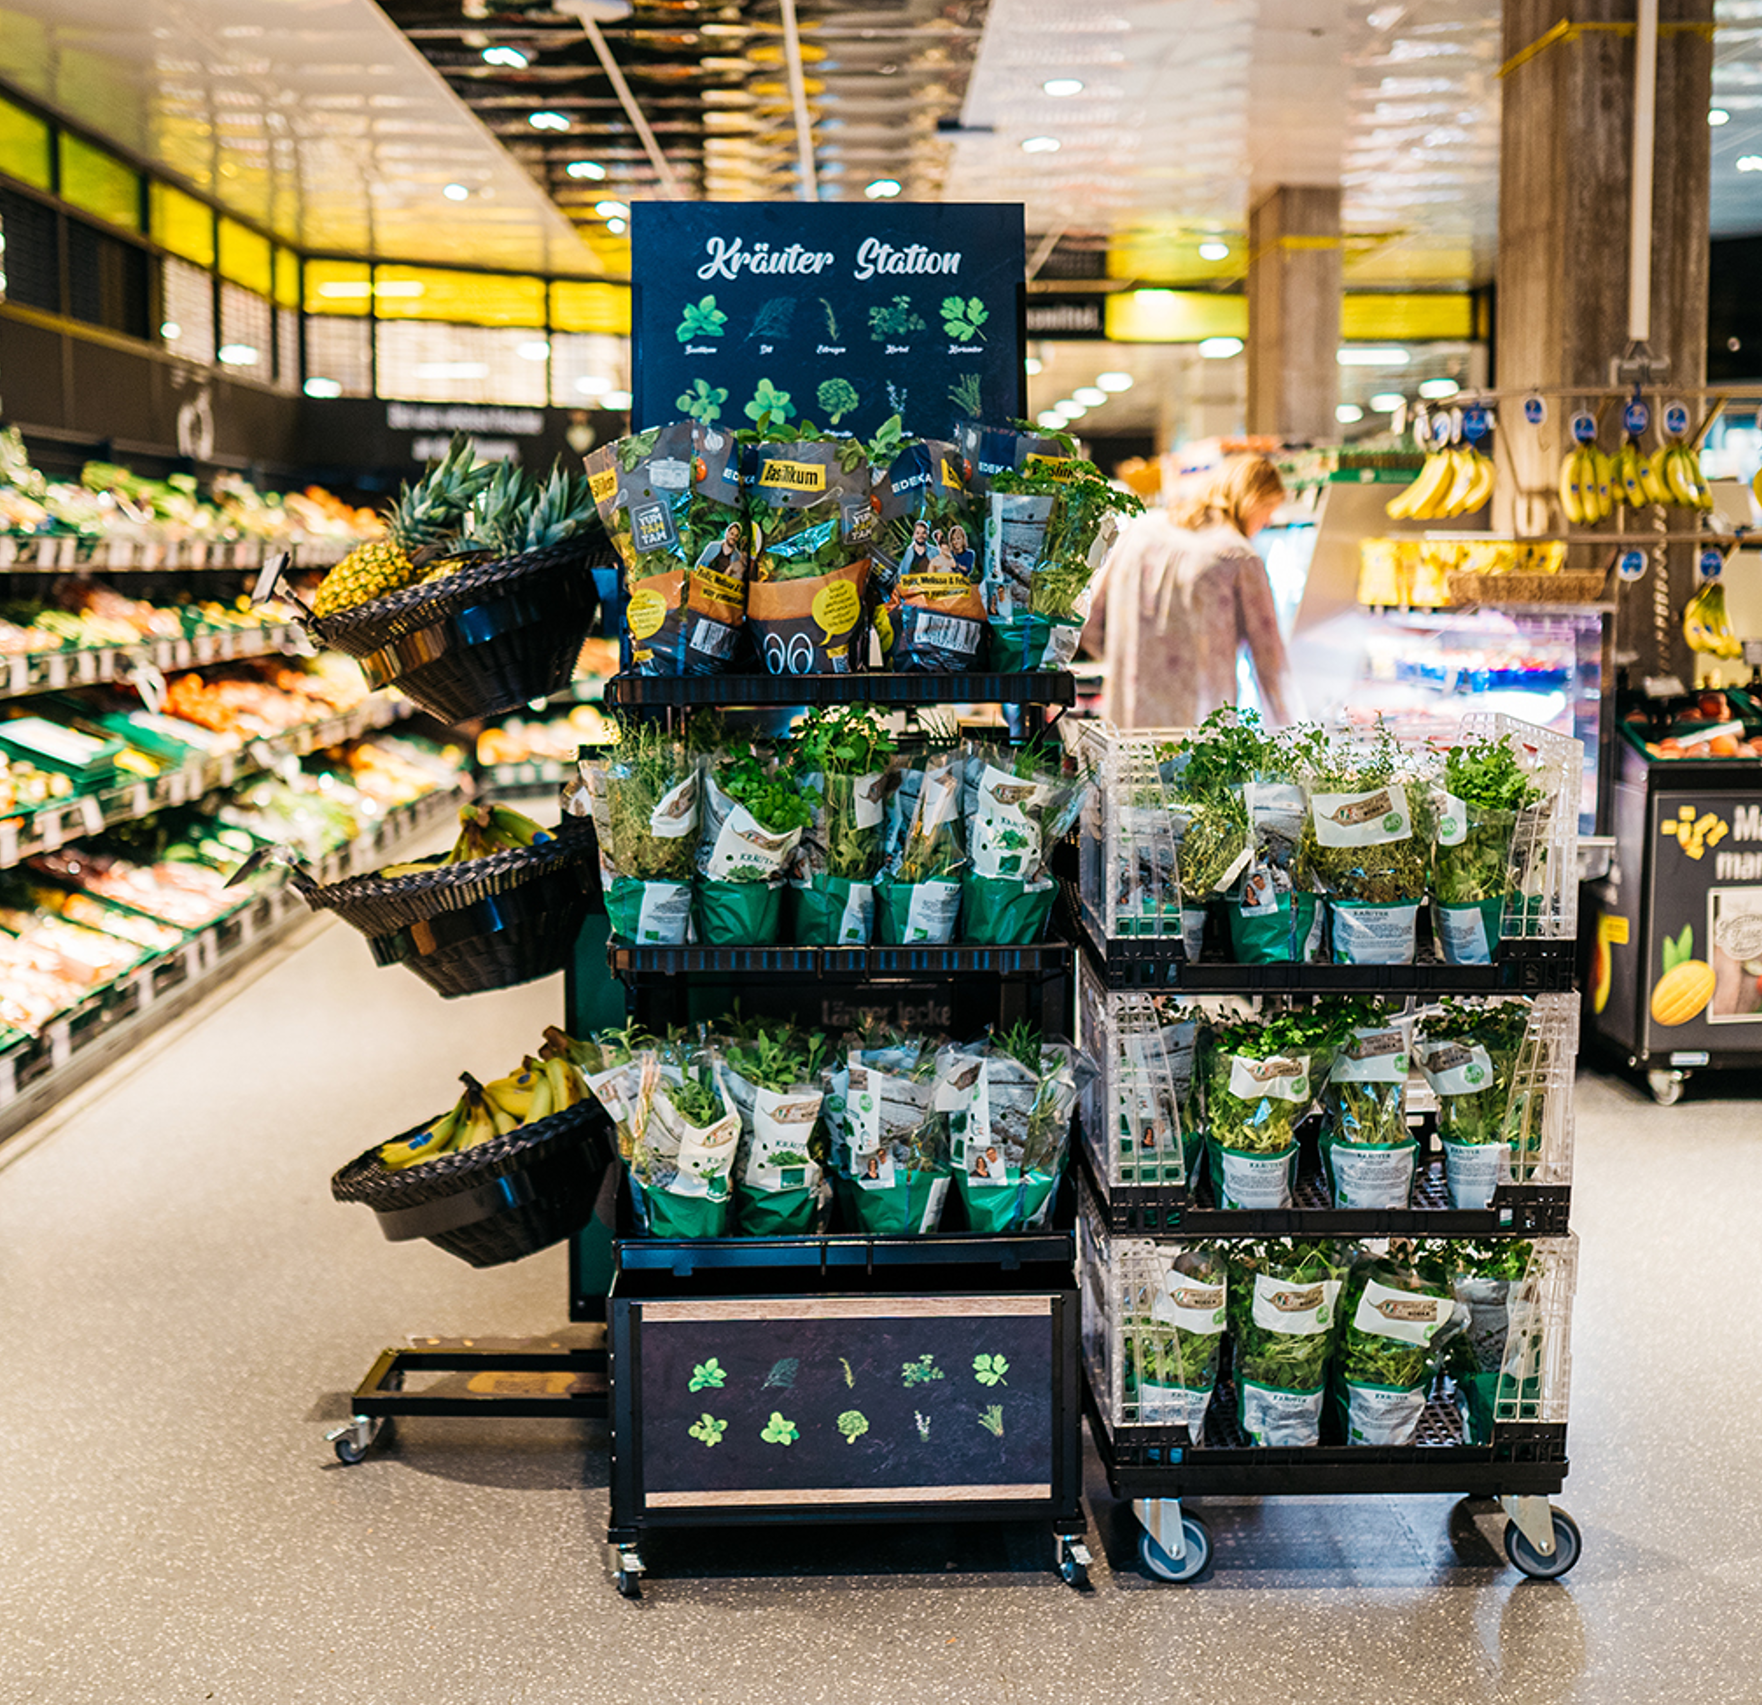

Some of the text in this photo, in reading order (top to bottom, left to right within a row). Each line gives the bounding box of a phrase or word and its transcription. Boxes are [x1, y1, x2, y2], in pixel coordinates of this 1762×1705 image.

[696, 236, 962, 280] Kräuter Station
[891, 473, 933, 493] EDEKA
[642, 530, 667, 544] TAM
